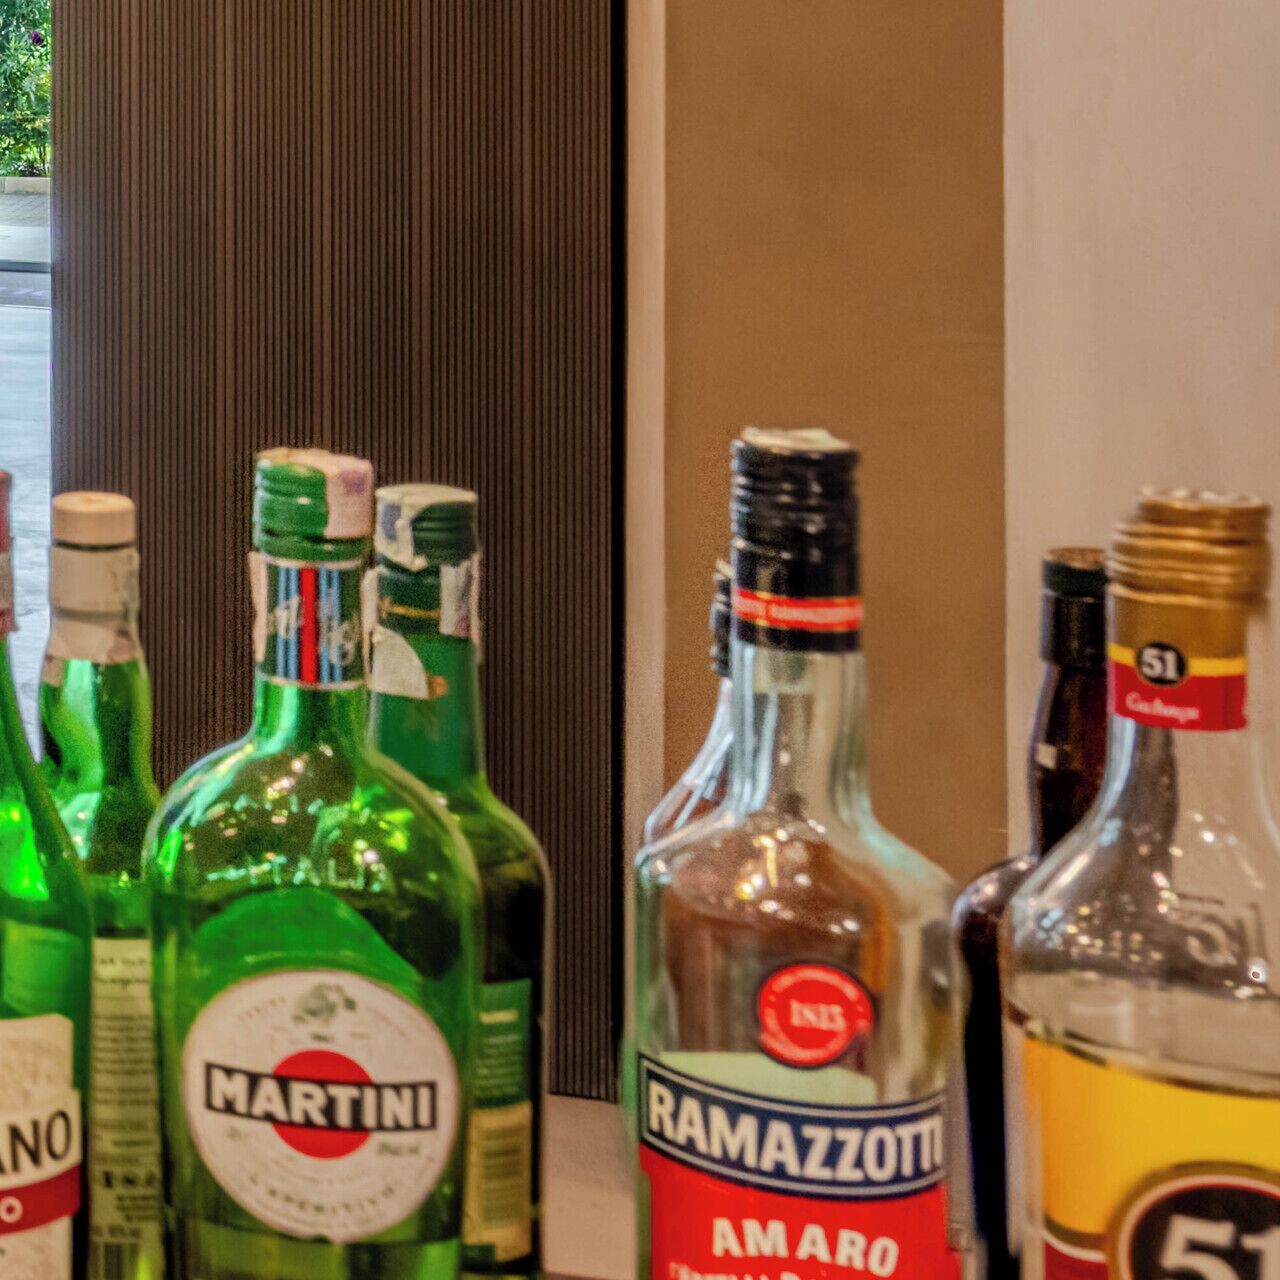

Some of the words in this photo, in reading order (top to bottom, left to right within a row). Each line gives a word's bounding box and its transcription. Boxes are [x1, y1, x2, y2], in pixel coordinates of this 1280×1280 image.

[1141, 646, 1179, 681] 51
[208, 1066, 434, 1129] MARTINI
[648, 1080, 944, 1183] RAMAZZOTTI
[712, 1216, 900, 1278] AMARO
